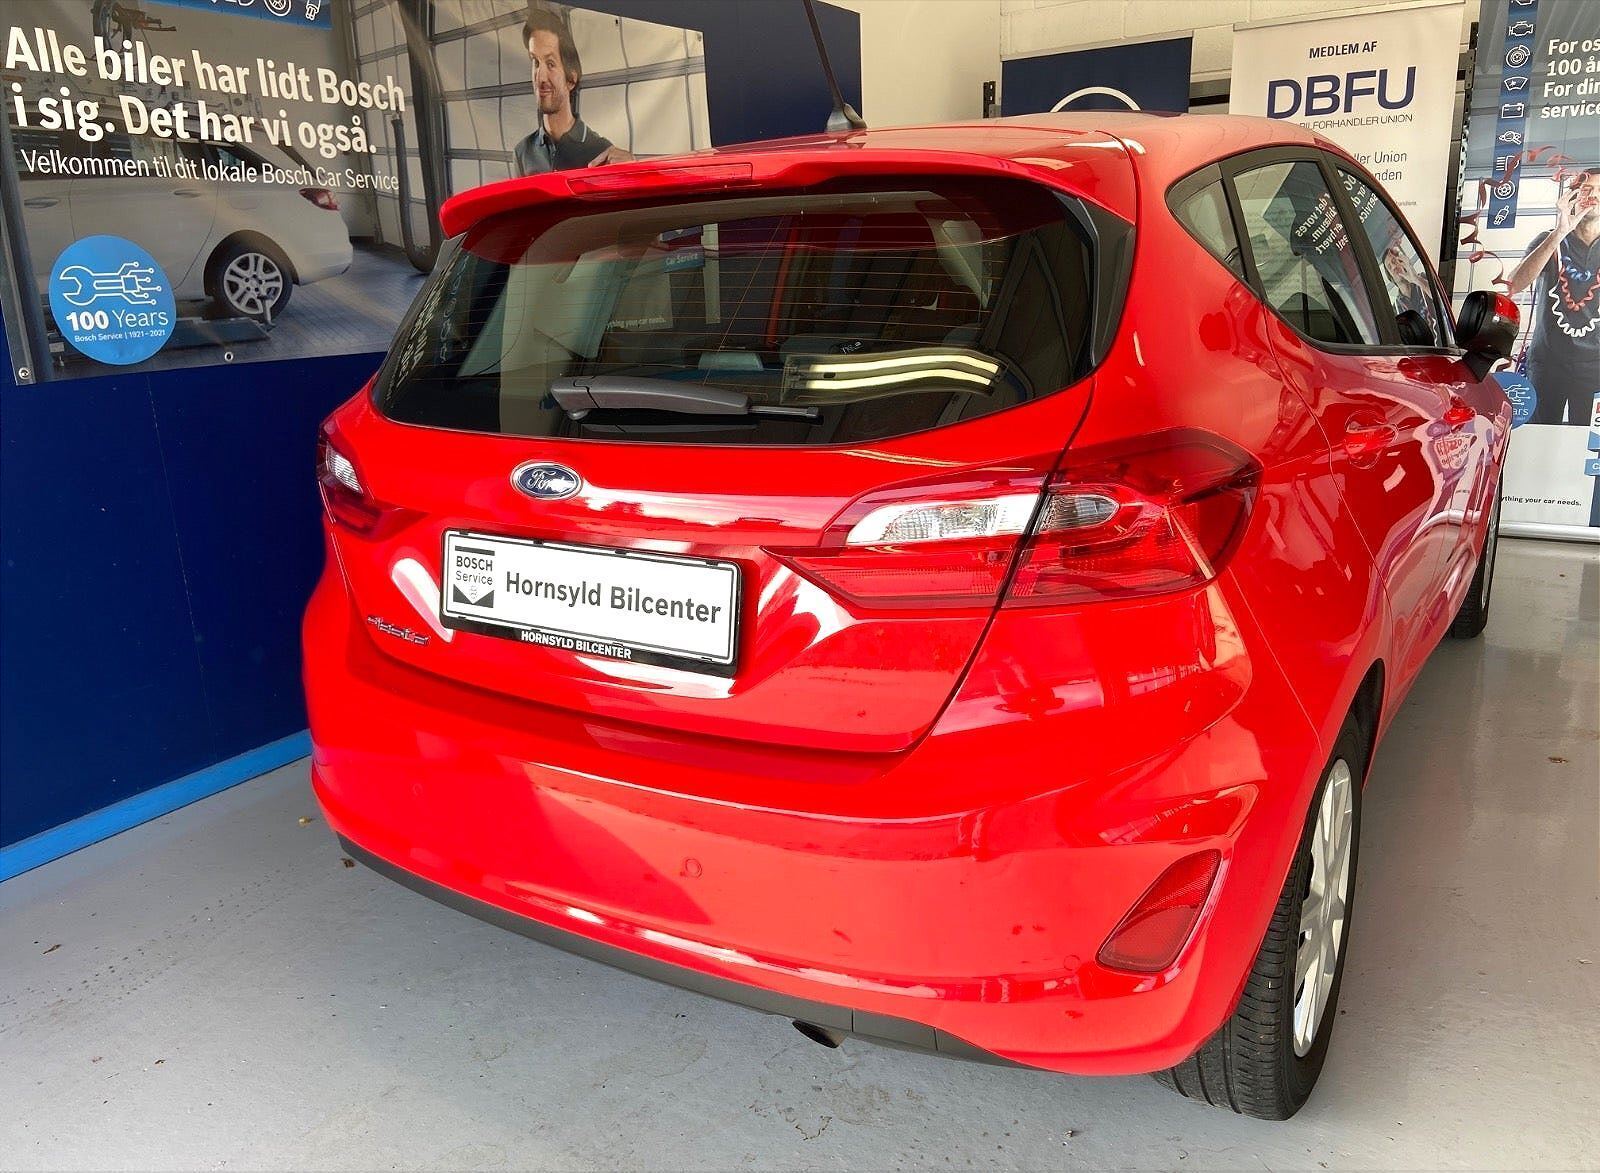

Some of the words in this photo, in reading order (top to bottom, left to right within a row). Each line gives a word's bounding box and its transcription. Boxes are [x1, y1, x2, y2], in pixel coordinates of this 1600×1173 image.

[1309, 43, 1360, 59] MEDLEM
[1362, 40, 1378, 53] AF
[1548, 38, 1579, 56] For
[5, 26, 88, 76] Alle
[94, 35, 186, 87] biler
[191, 49, 250, 95] har
[256, 58, 314, 102] lidt
[316, 67, 406, 112] Bosch
[1546, 58, 1582, 77] 100
[1266, 66, 1417, 119] DBFU
[1543, 81, 1574, 98] For
[11, 82, 28, 127] i
[37, 86, 116, 142] sig.
[118, 94, 191, 139] Det
[198, 99, 254, 143] har
[261, 109, 293, 147] vi
[298, 114, 377, 159] også.
[1380, 114, 1413, 124] UNION
[1374, 151, 1407, 164] Union
[20, 149, 151, 177] Velkommen
[152, 155, 172, 178] til
[175, 157, 200, 180] dit
[201, 158, 258, 183] lokale
[262, 162, 314, 186] Bosch
[315, 166, 342, 188] Car
[345, 168, 399, 190] Service
[66, 310, 109, 331] 100
[111, 309, 169, 328] Years
[74, 333, 97, 342] Bosch
[98, 332, 123, 341] Service
[1513, 408, 1529, 416] ars
[1525, 497, 1541, 505] your
[1557, 498, 1582, 506] needs.
[455, 555, 493, 572] BOSCH
[455, 570, 494, 586] Service
[506, 570, 601, 608] Hornsyld
[610, 585, 722, 624] Bilcenter
[521, 630, 574, 650] HORNSYLD
[575, 639, 632, 660] BILCENTER
